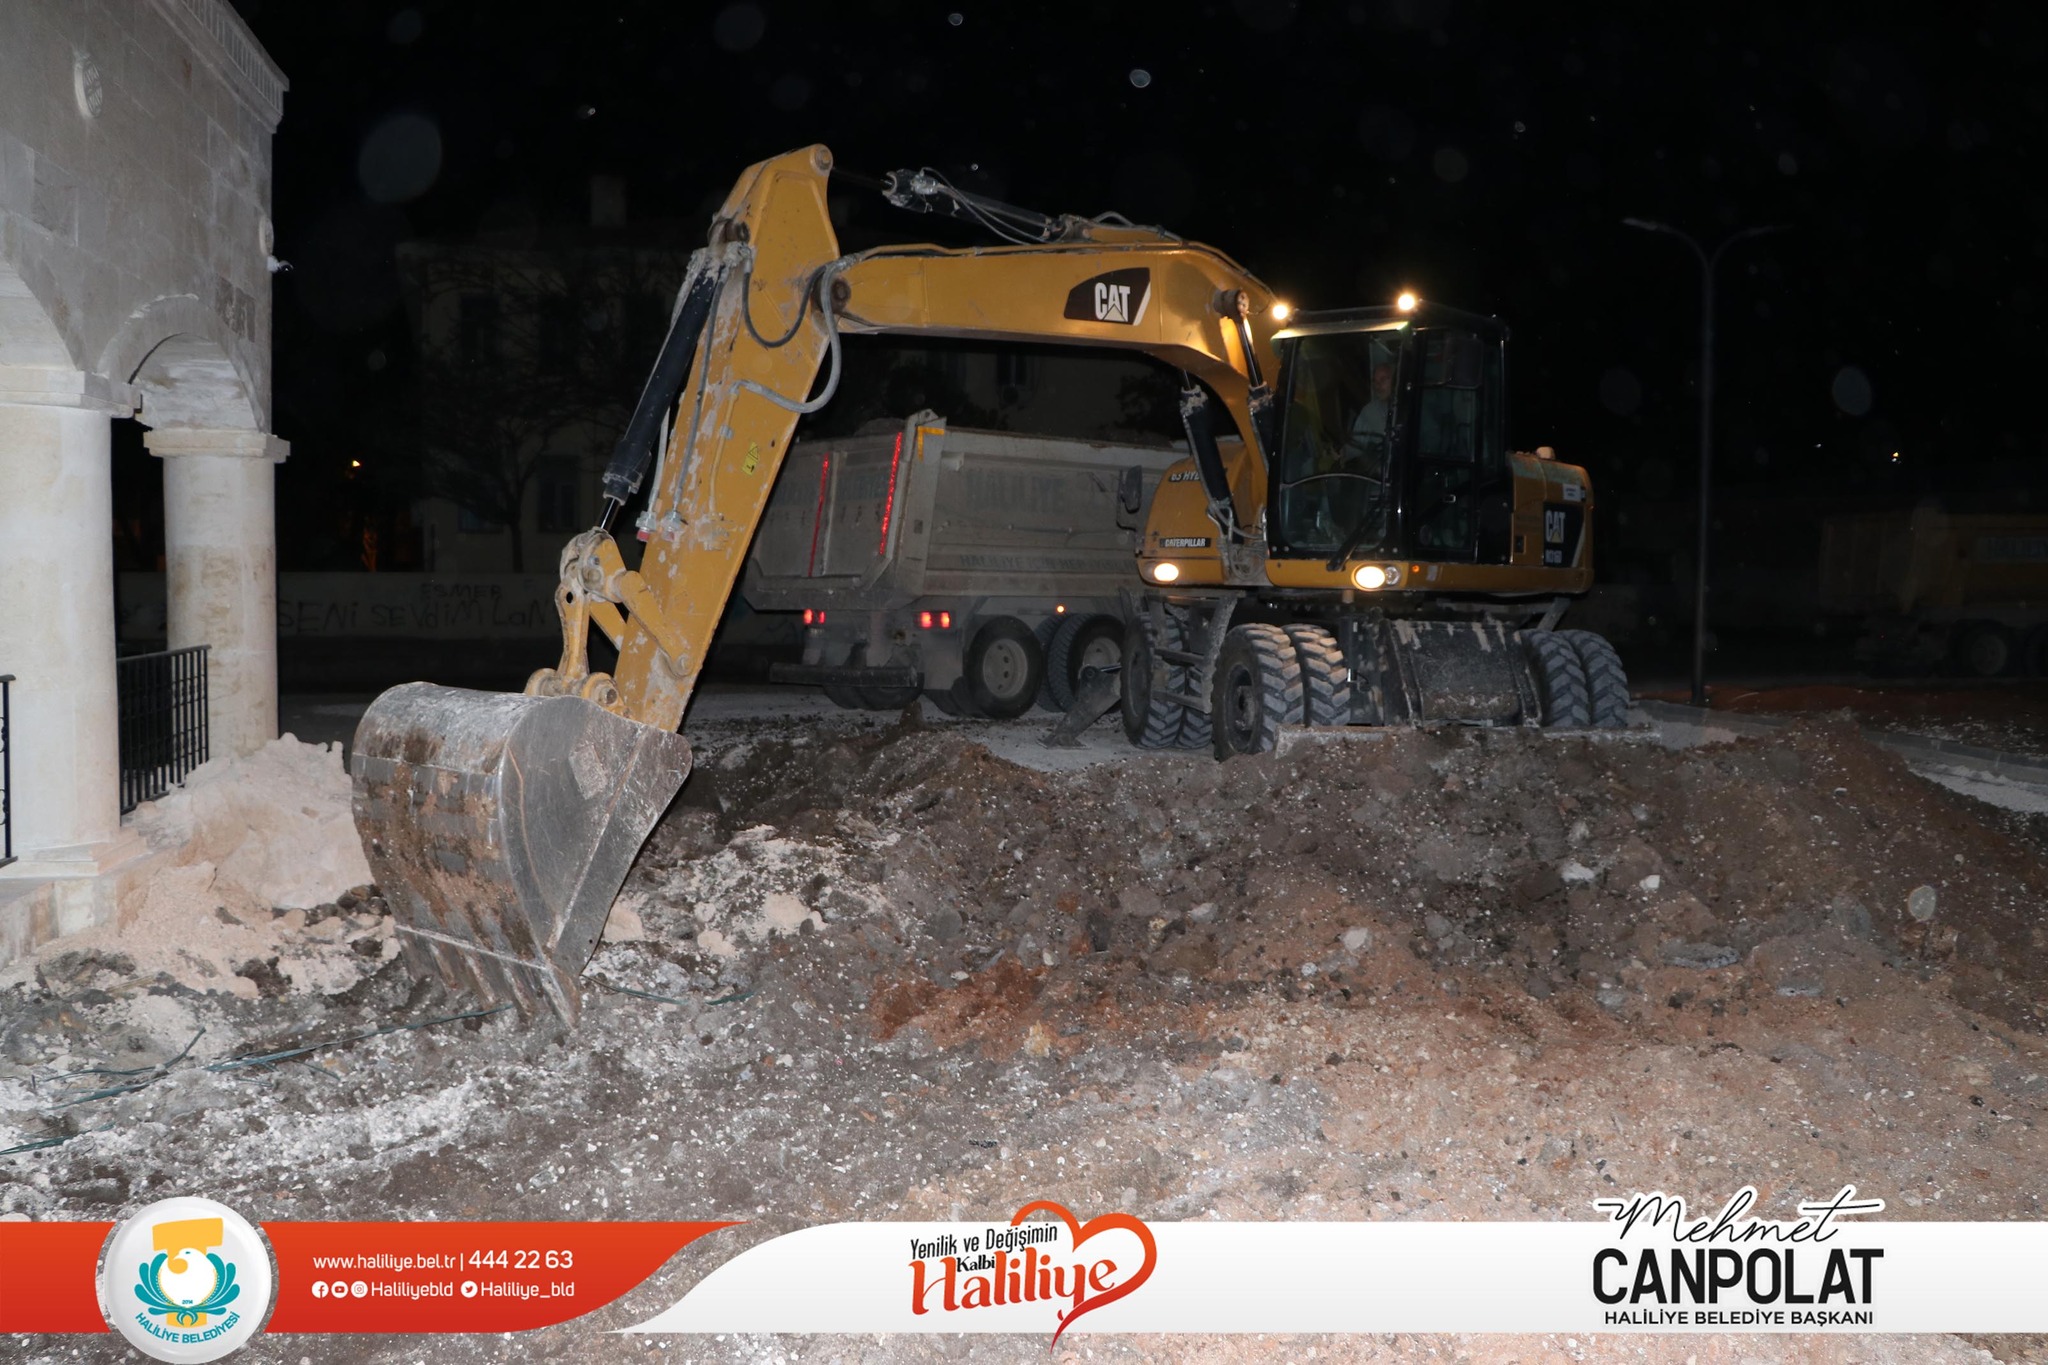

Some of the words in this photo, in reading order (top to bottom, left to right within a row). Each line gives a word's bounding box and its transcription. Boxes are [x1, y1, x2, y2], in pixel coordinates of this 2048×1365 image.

[1094, 282, 1131, 322] CAT
[1164, 538, 1206, 547] CATERPILLAR
[1545, 509, 1566, 543] CAT
